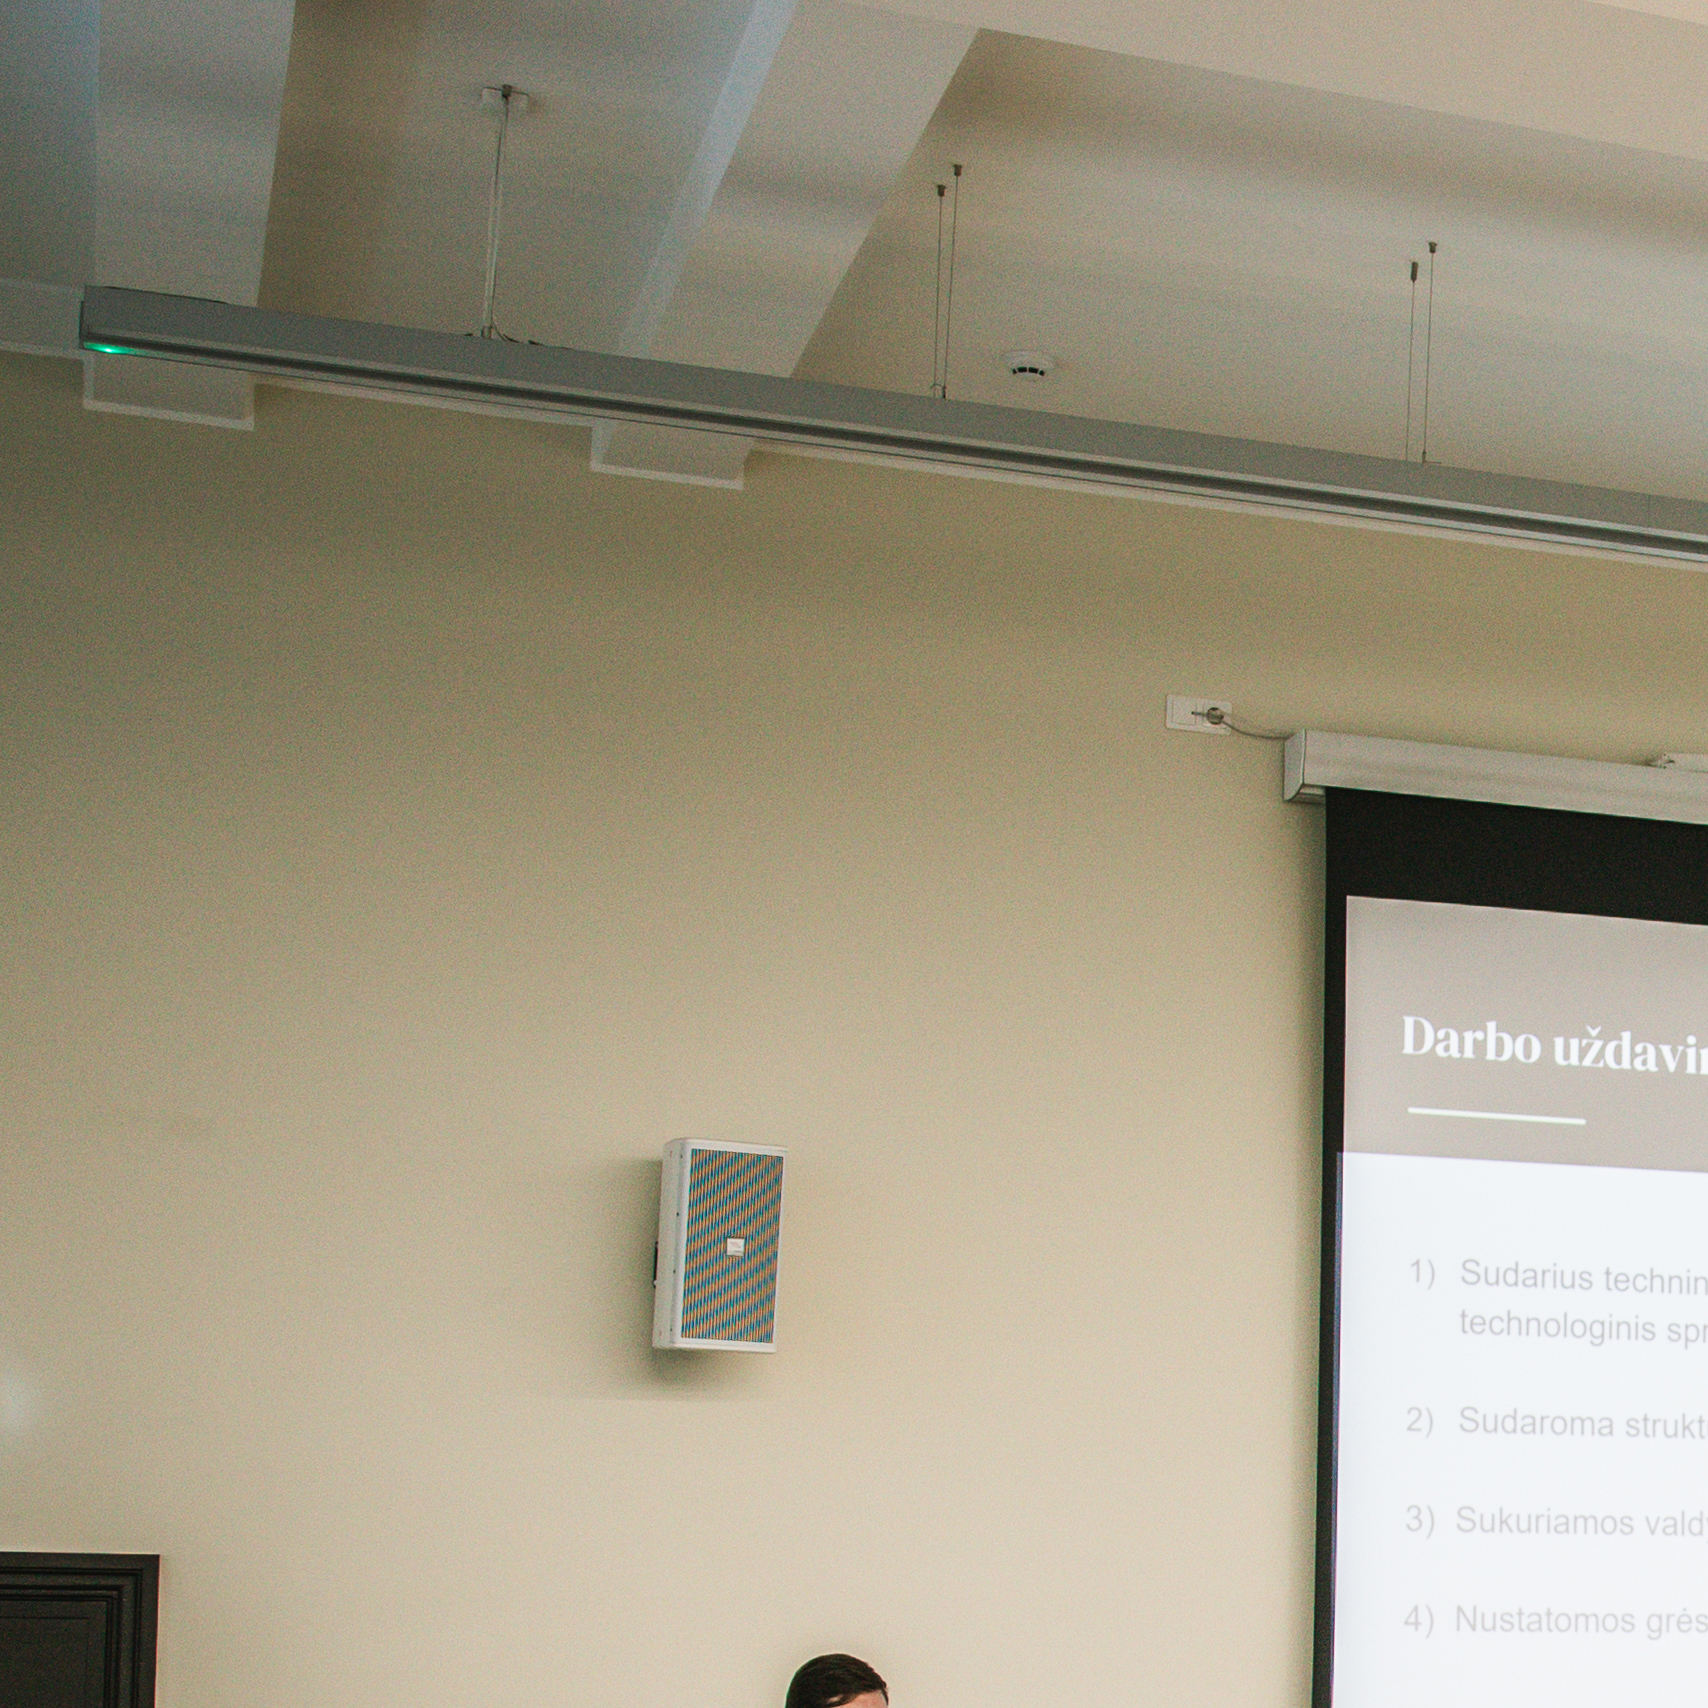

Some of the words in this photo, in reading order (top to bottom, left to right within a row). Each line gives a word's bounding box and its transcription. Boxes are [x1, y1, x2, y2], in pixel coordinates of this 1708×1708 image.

[1402, 1015, 1542, 1064] Darbo
[1410, 1258, 1436, 1290] 1)
[1460, 1257, 1594, 1291] Sudarius
[1459, 1308, 1657, 1348] technologinis
[1405, 1406, 1435, 1438] 2)
[1458, 1405, 1614, 1438] Sudaroma
[1405, 1504, 1436, 1539] 3)
[1455, 1504, 1635, 1536] Sukuriamos
[1403, 1604, 1435, 1638] 4)
[1455, 1604, 1636, 1634] Nustatomos
